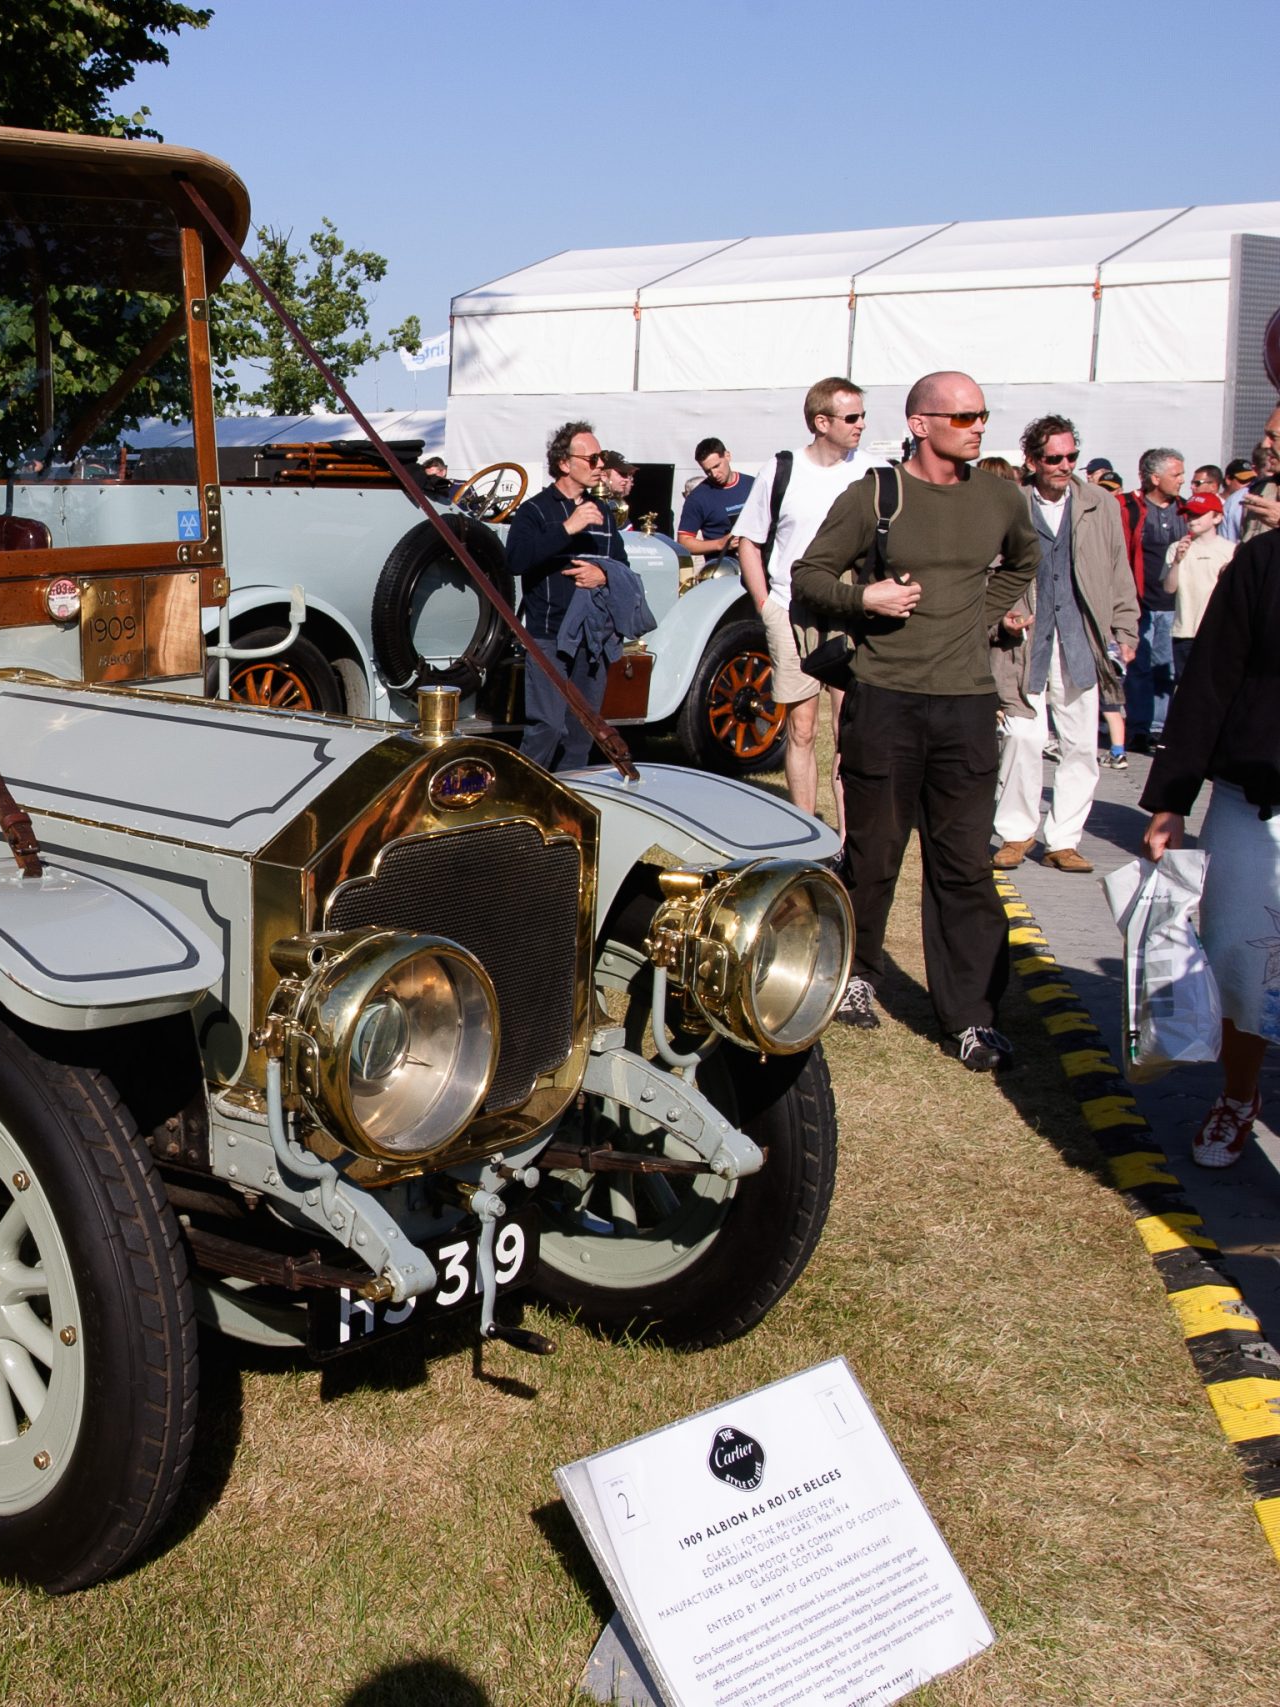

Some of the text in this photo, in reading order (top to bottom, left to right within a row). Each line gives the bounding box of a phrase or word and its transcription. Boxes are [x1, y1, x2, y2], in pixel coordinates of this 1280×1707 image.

[89, 615, 136, 642] 1909
[719, 1430, 735, 1442] THE
[714, 1442, 754, 1468] Cartier
[725, 1461, 763, 1489] STYLE ET LUXE
[617, 1492, 635, 1519] 2
[678, 1468, 841, 1549] 1909 ALBION A6 ROI DE BELGES
[706, 1545, 731, 1562] CLASS
[740, 1533, 758, 1546] FOR
[757, 1524, 775, 1537] THE
[775, 1505, 818, 1529] PRIVILEGED
[818, 1497, 835, 1509] FEW
[702, 1550, 752, 1578] EDWARDIAN
[752, 1530, 790, 1552] TOURING
[728, 1567, 758, 1586] ALBION
[758, 1552, 788, 1570] MOTOR
[789, 1543, 806, 1557] CAR
[807, 1525, 843, 1548] COMPANY
[845, 1518, 856, 1530] OF
[791, 1543, 833, 1569] SCOTLAND
[706, 1608, 744, 1633] ENTERED
[786, 1581, 797, 1593] OF
[835, 1535, 891, 1567] WARWICKSHIRE
[877, 1682, 891, 1692] THE
[891, 1668, 913, 1685] EXHIBIT
